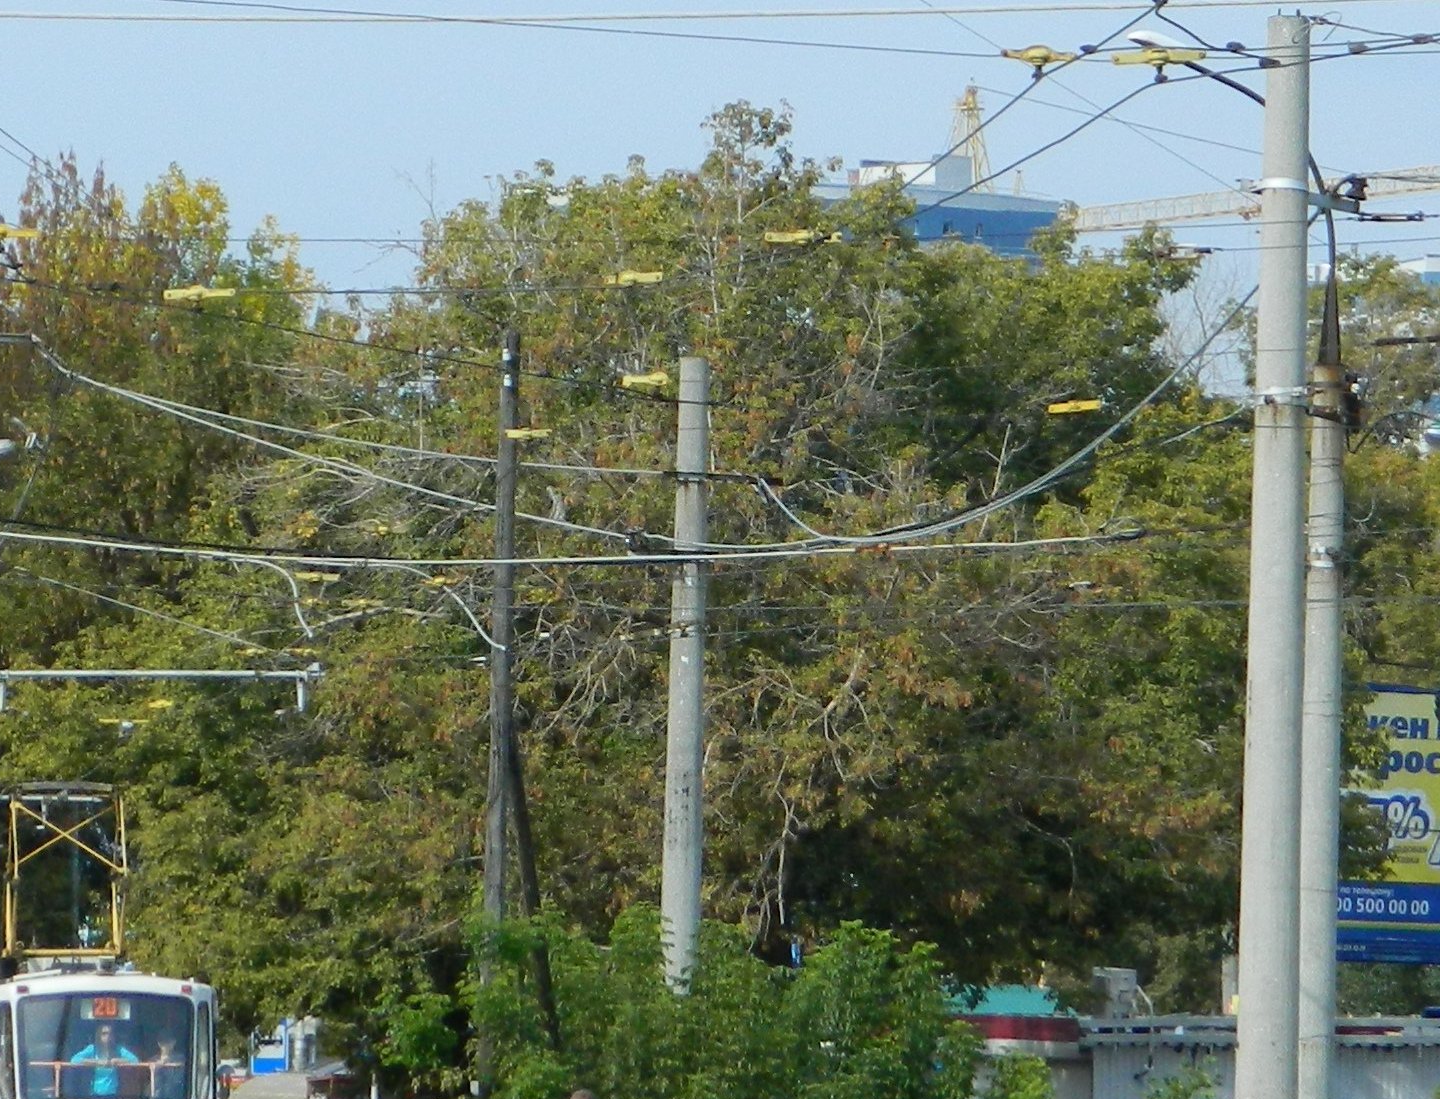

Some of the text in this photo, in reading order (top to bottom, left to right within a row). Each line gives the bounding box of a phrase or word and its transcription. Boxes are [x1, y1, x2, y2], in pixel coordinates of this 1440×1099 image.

[1356, 897, 1385, 914] 500
[1388, 899, 1407, 915] 00
[1410, 900, 1429, 916] 00
